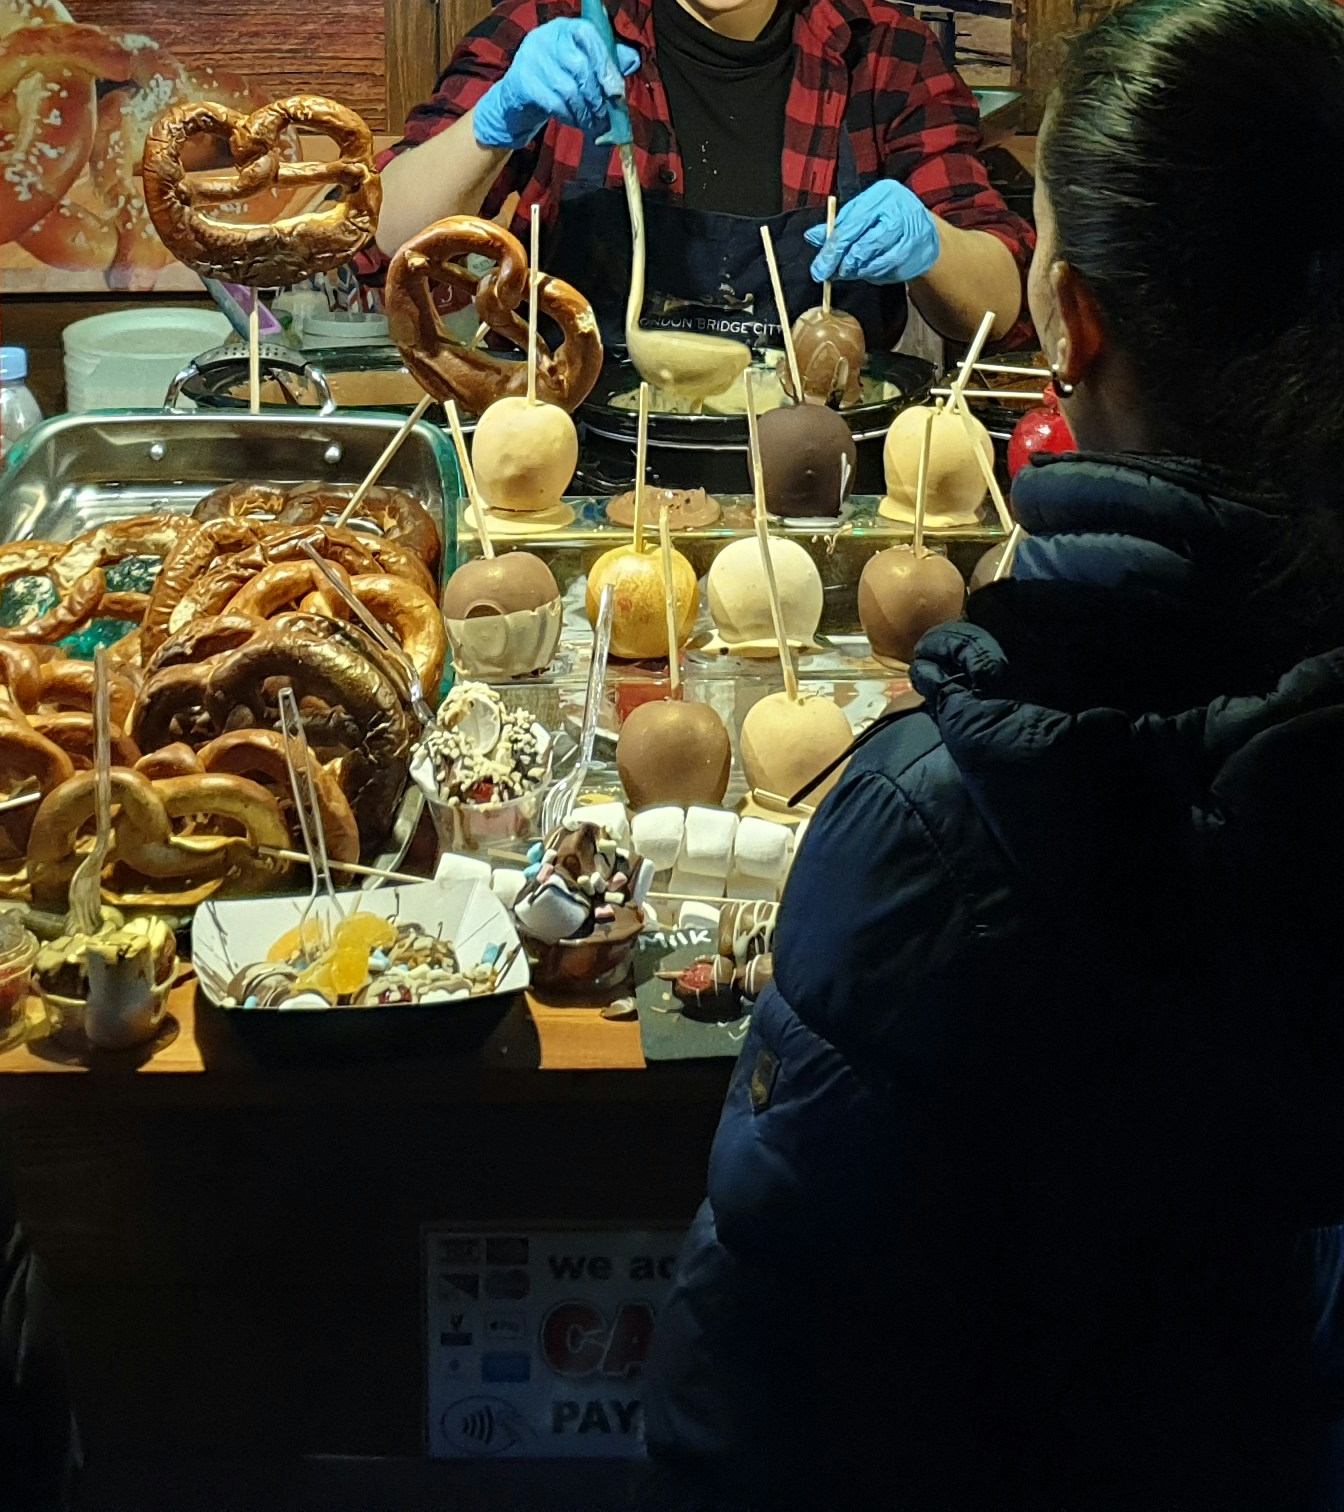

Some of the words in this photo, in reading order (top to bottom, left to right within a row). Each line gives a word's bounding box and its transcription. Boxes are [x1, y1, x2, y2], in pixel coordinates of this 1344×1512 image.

[639, 317, 693, 329] ONDON
[548, 1255, 614, 1280] we
[551, 1399, 640, 1434] PAY
